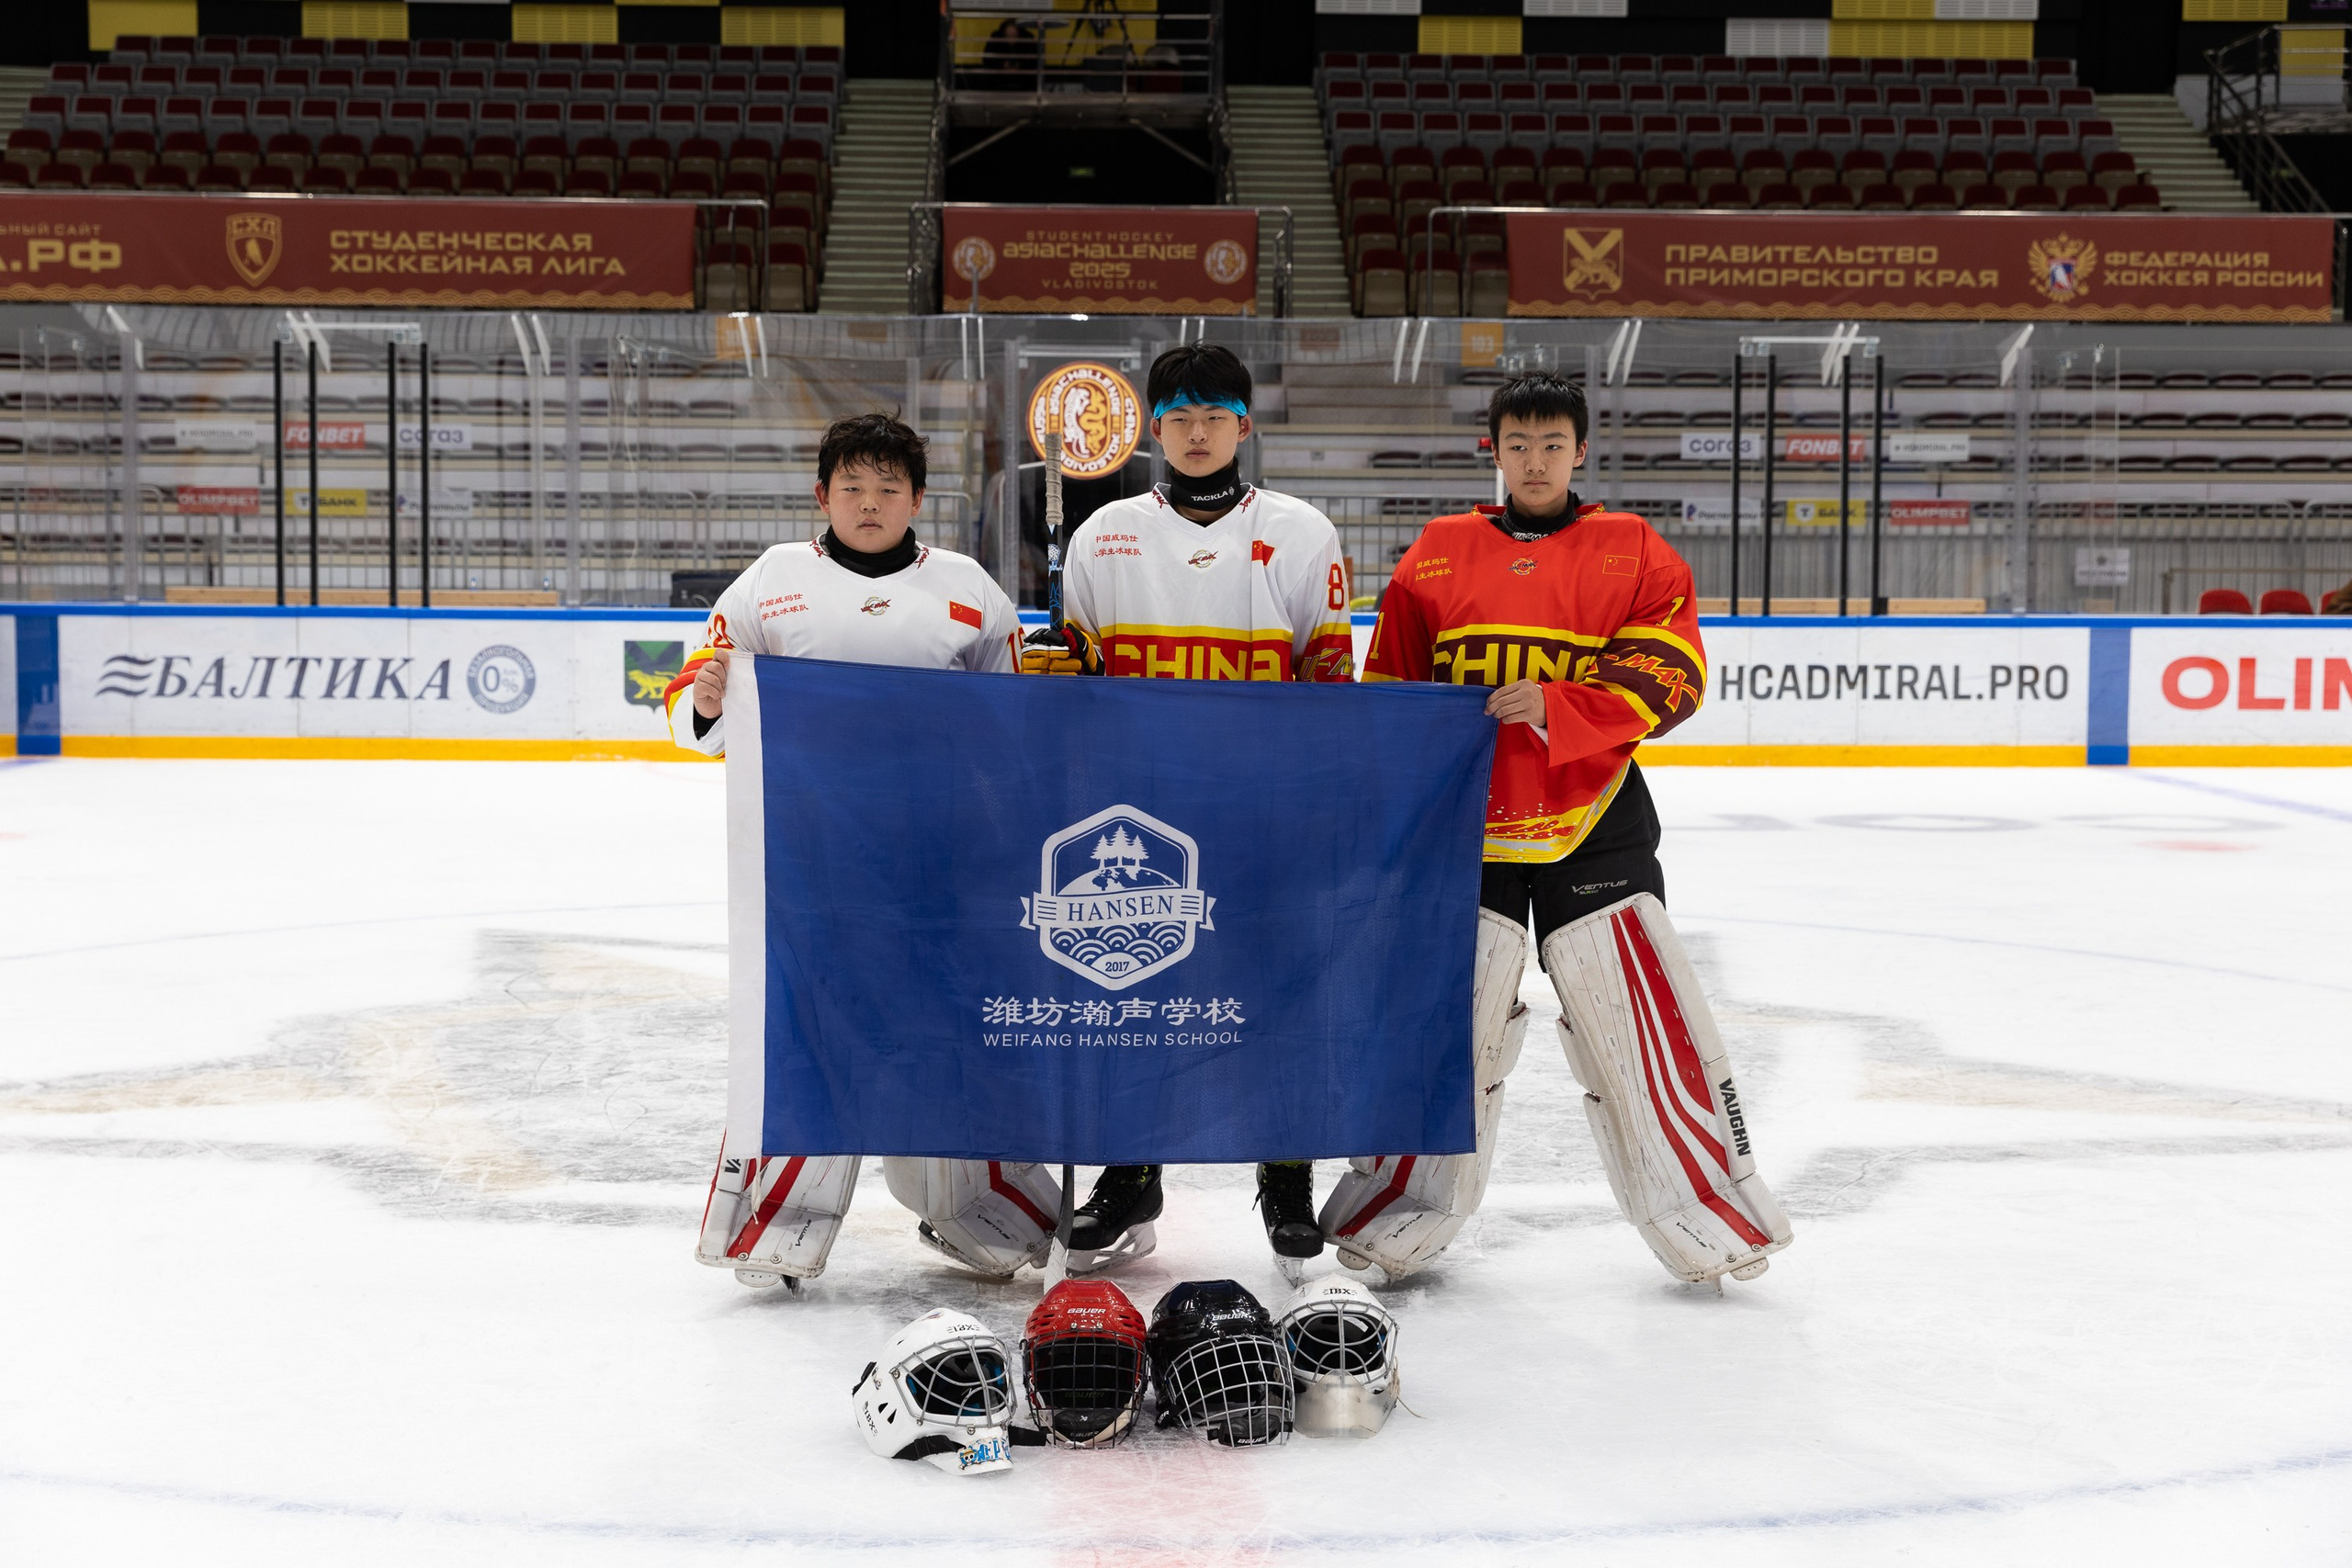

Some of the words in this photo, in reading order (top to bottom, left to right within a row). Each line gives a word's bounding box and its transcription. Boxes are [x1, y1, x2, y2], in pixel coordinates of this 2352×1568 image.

[54, 222, 101, 236] САЙТ
[1026, 231, 1102, 242] STUDENT
[1108, 231, 1175, 243] HOCKEY
[330, 230, 593, 252] СТУДЕНЧЕСКАЯ
[329, 251, 533, 275] ХОККЕЙНАЯ
[540, 256, 627, 276] ЛИГА
[1665, 244, 1939, 265] ПРАВИТЕЛЬСТВО
[2104, 251, 2270, 268] ФЕДЕРАЦИЯ
[1069, 261, 1131, 278] 2025
[1665, 267, 1905, 288] ПРИМОРСКОГО
[1914, 269, 1999, 288] КРАЯ
[1041, 278, 1159, 290] VLADIVOSTOK
[2103, 270, 2210, 287] ХОККЕЯ
[2216, 271, 2324, 288] РОССИИ
[1788, 438, 1863, 456] FONBT
[1191, 490, 1228, 502] TACKLA
[1817, 508, 1857, 519] БАК
[1891, 507, 1968, 519] OLIMPBET
[1328, 562, 1345, 611] 8
[1655, 596, 1686, 627] 1
[1369, 611, 1385, 660] 1
[152, 655, 451, 700] БАЛТИКА
[1719, 662, 2070, 701] HCADMIRAL.PRO
[1571, 879, 1628, 894] VENTUS
[1068, 895, 1174, 921] HANSEN
[1104, 961, 1130, 973] 2017
[982, 996, 1247, 1027] 潍坊瀚声学校
[983, 1033, 1072, 1047] WEIFANG
[1079, 1033, 1158, 1047] HANSEN
[1164, 1032, 1243, 1045] SCHOOL
[1718, 1077, 1751, 1156] VAUGHN
[1329, 1287, 1351, 1295] IBX
[1212, 1313, 1249, 1322] BAUER
